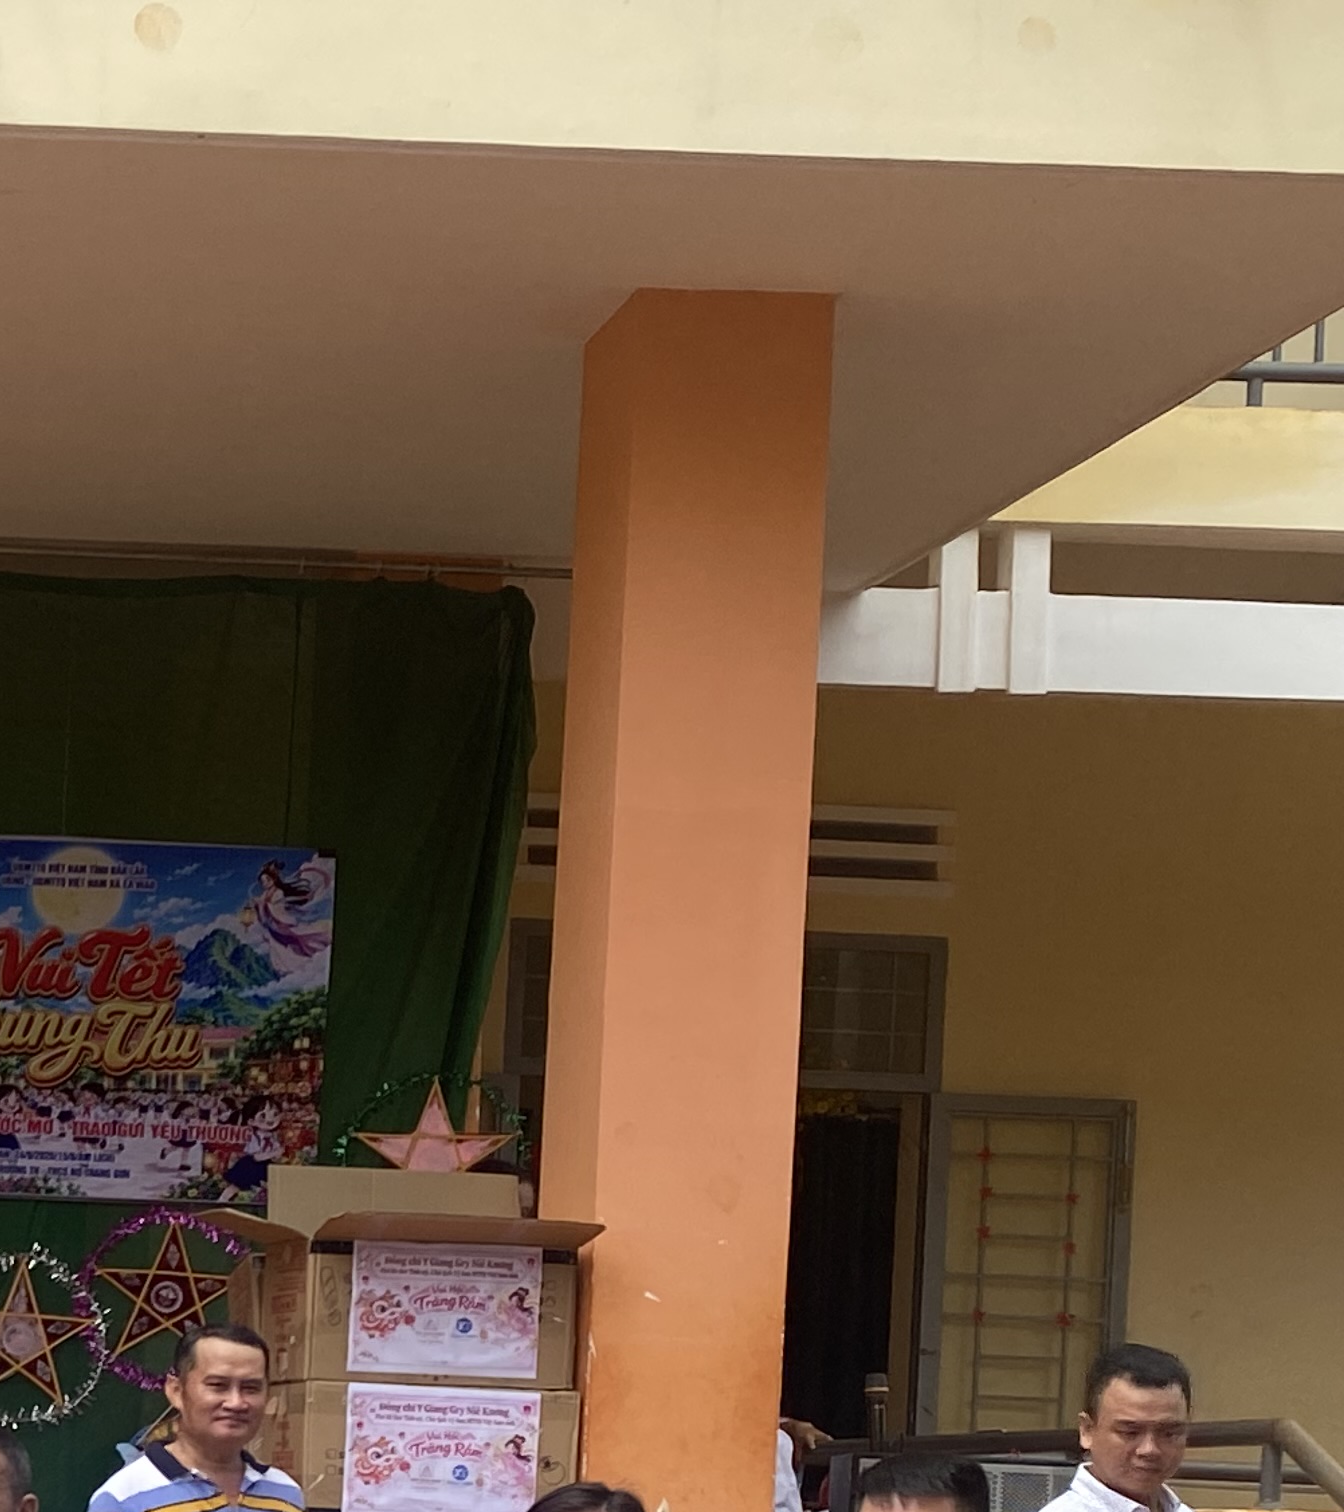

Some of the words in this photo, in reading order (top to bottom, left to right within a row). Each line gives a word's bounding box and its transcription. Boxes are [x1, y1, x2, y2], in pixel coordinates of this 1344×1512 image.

[78, 924, 184, 1001] Tết
[97, 1000, 202, 1075] Thu
[414, 1295, 456, 1311] Trăng
[409, 1443, 450, 1457] Trăng
